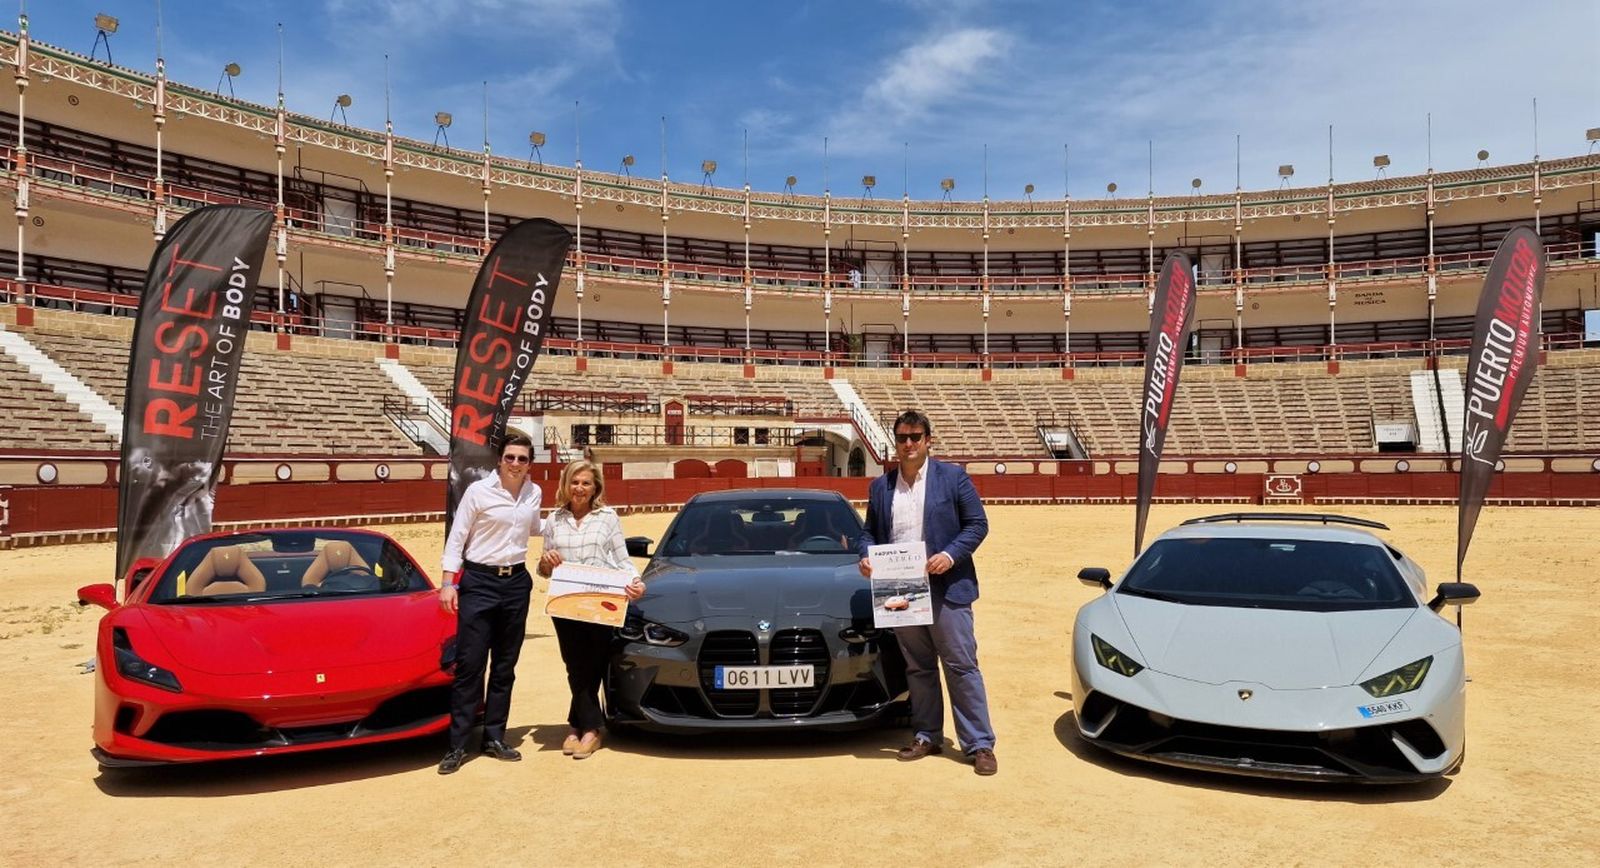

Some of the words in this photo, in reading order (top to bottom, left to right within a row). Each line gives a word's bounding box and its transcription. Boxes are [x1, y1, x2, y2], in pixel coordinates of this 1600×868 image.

[222, 256, 250, 320] BODY
[524, 272, 549, 336] BODY
[143, 243, 223, 440] RESET
[216, 324, 236, 354] OF
[452, 256, 529, 446] RESET
[516, 339, 534, 369] OF
[1508, 330, 1529, 380] PREMIUM
[207, 355, 229, 400] ART
[502, 370, 523, 410] ART
[201, 401, 223, 440] THE
[489, 411, 503, 449] THE
[728, 670, 770, 686] 0611
[778, 669, 810, 685] LVV
